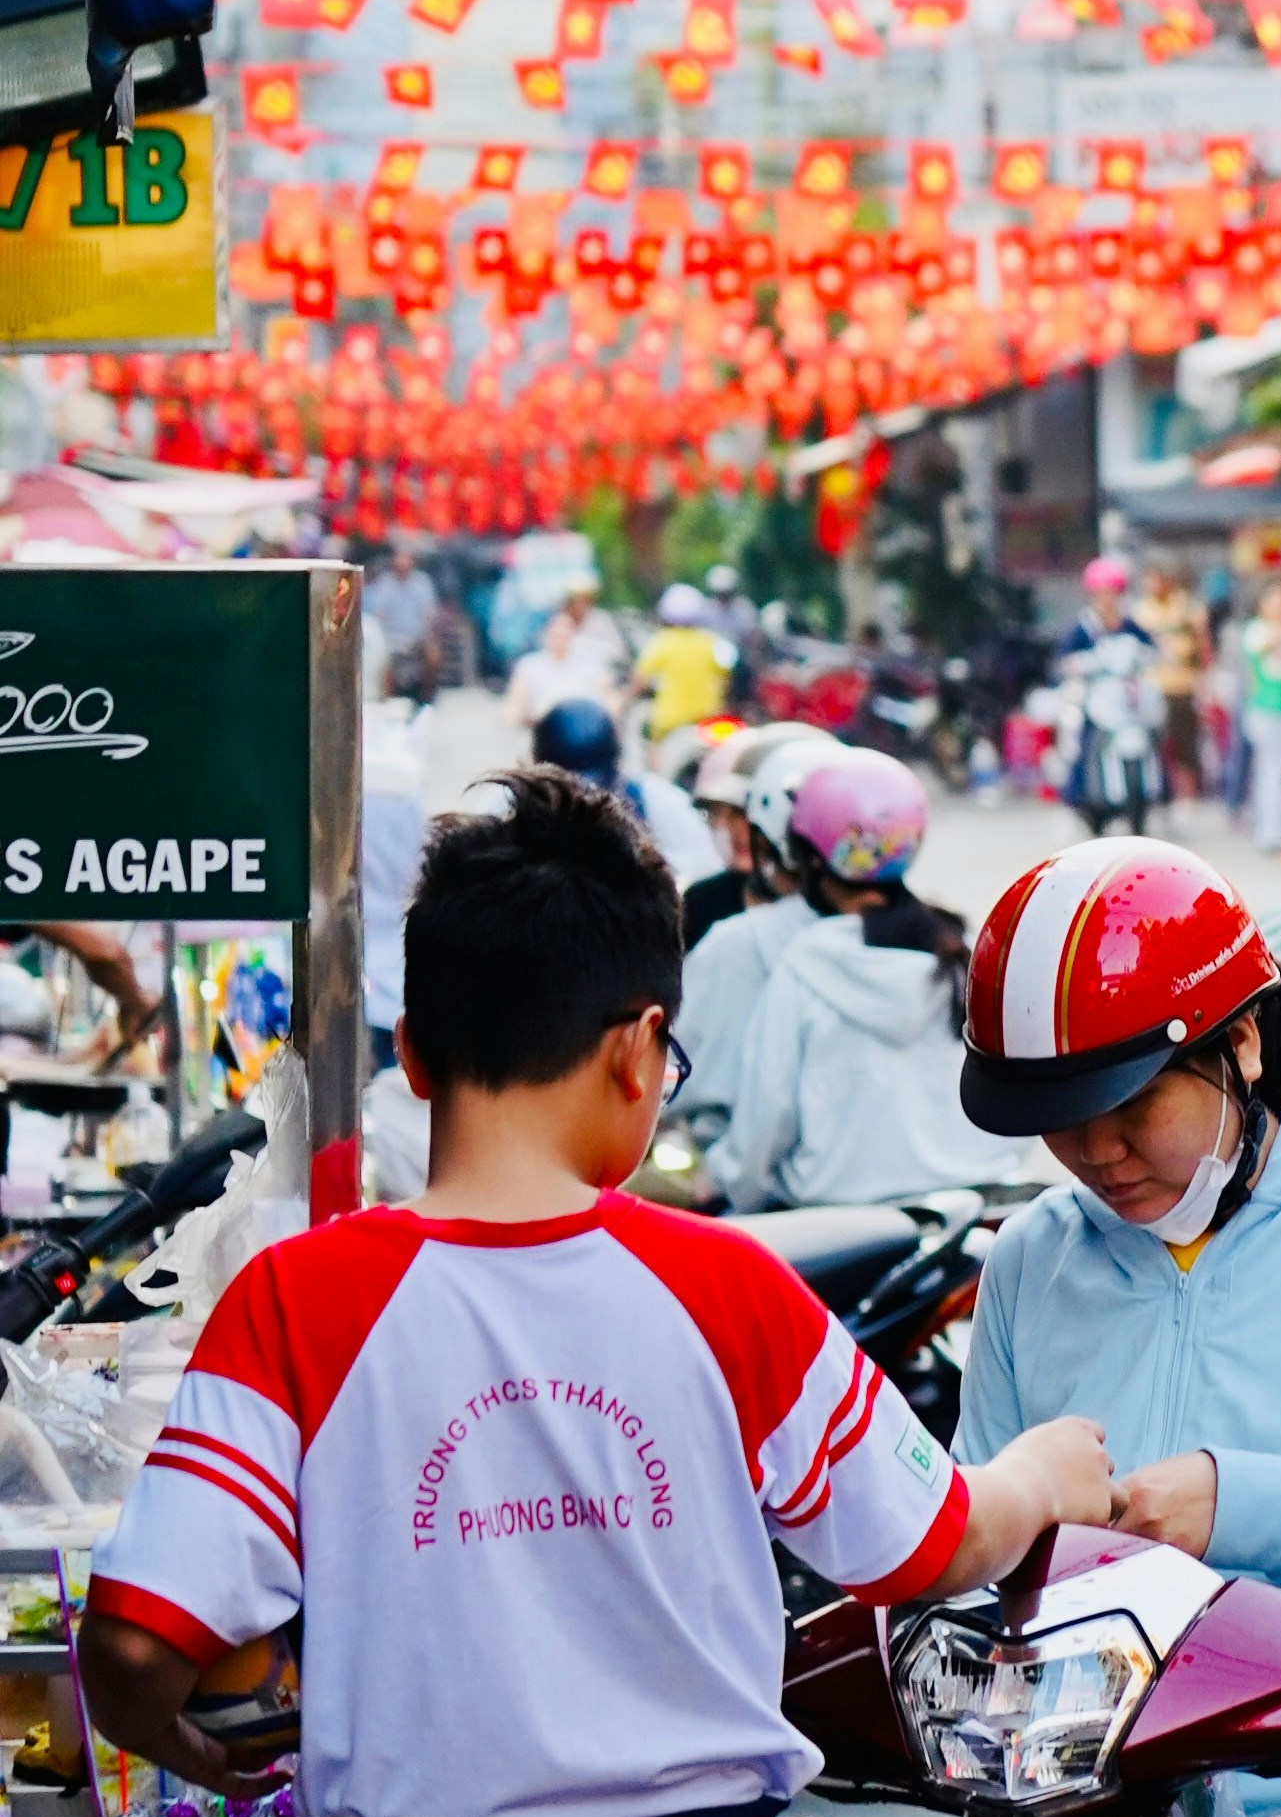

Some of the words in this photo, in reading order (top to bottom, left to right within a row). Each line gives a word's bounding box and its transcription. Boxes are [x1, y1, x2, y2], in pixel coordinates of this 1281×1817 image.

[64, 837, 266, 894] AGAPE
[464, 1378, 538, 1422] THCS
[636, 1439, 673, 1529] LONG
